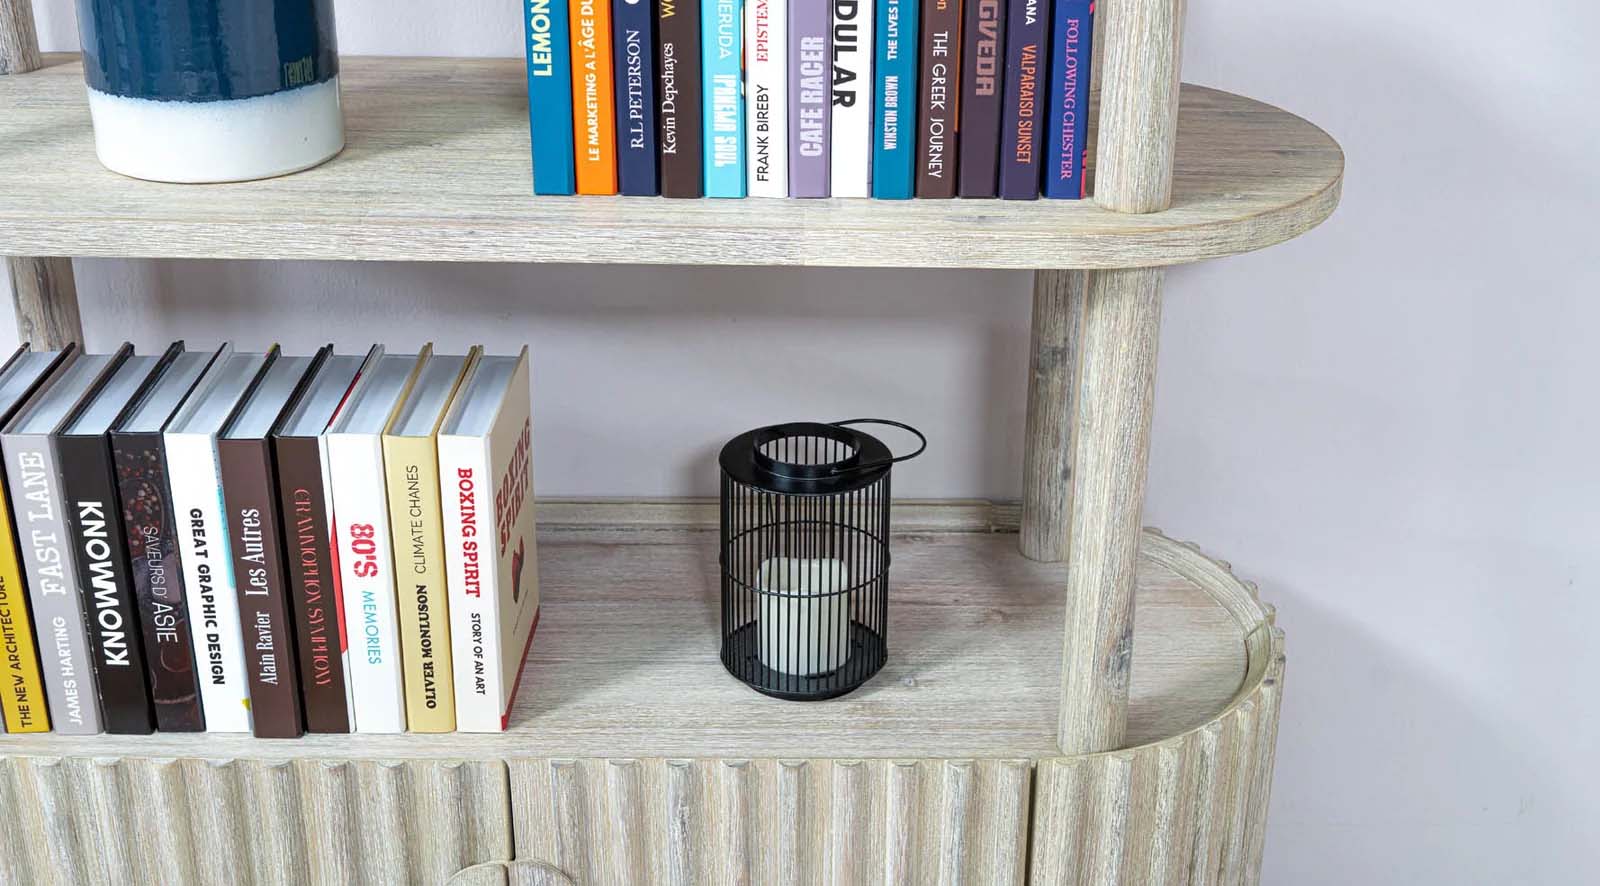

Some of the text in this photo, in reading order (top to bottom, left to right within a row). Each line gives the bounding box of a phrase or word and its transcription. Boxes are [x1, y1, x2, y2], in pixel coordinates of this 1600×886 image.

[531, 0, 552, 77] LEMON
[887, 8, 898, 39] LIVES
[887, 41, 898, 60] THE
[932, 31, 948, 57] THE
[626, 29, 643, 120] PETERSON
[660, 0, 680, 155] Kevin Depchayes W
[833, 0, 858, 108] DULAR
[1018, 44, 1036, 123] VALPARAISO
[584, 74, 599, 146] MARKETING
[756, 85, 769, 132] BIREBY
[800, 36, 825, 157] CAFE RACER
[885, 75, 899, 108] BROWN
[930, 64, 947, 110] GREEK
[1061, 19, 1079, 179] FOLLOWING CHESTER
[589, 149, 600, 161] LE
[714, 136, 737, 167] SOUL
[756, 135, 769, 182] FRANK
[884, 109, 898, 150] WINSTON
[928, 118, 945, 178] JOURNEY
[1016, 126, 1032, 164] SUNSET
[18, 452, 66, 597] FAST LANE
[143, 526, 165, 585] SAVEURS
[457, 467, 486, 695] BOXING SPIRIT STORY OF AN ART
[189, 508, 226, 685] GREAT GRAPHIC DESIGN
[241, 508, 279, 685] Alain Ravier Les Autres
[350, 523, 382, 665] 80'S MEMORIES
[406, 464, 437, 710] OLIVER MONLUSON CLIMATE CHANES
[152, 602, 178, 644] ASIE
[12, 674, 28, 702] NEW
[52, 616, 83, 726] JAMES HARTING
[19, 704, 33, 728] THE
